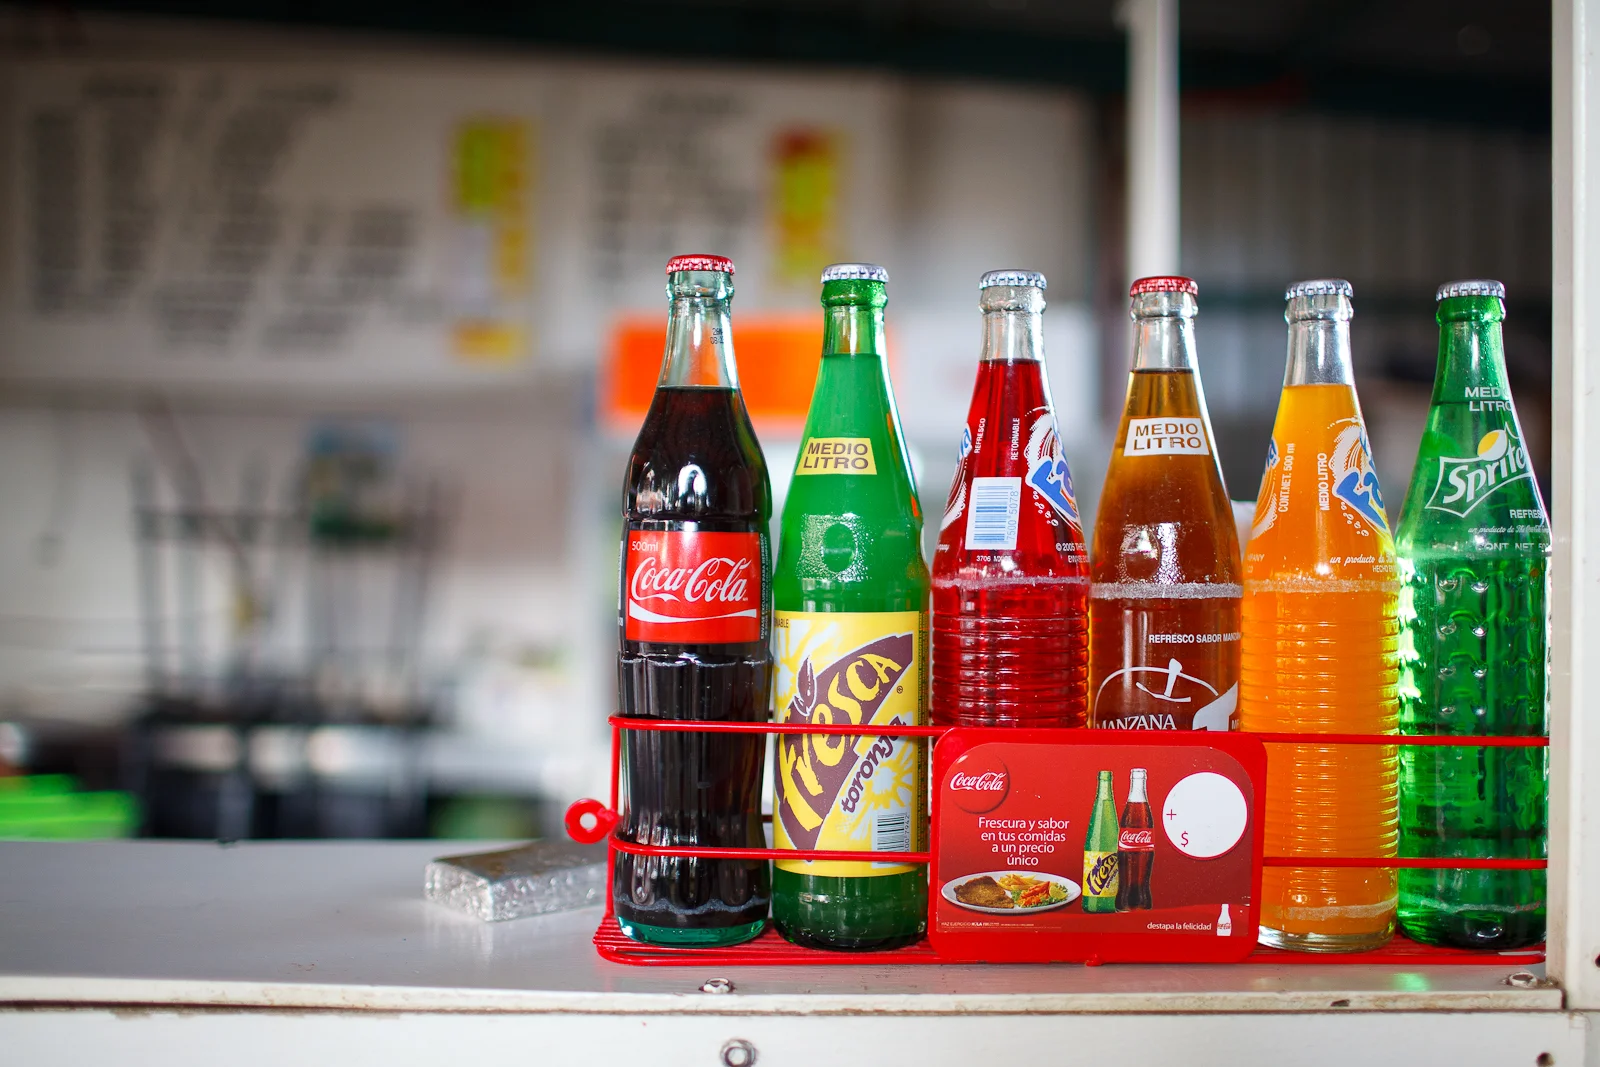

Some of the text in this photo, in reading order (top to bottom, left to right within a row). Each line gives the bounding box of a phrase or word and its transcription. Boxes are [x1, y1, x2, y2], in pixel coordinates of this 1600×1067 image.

[973, 417, 986, 454] REFRESCO
[1135, 423, 1199, 437] MEDIO
[1010, 417, 1020, 460] RETORNABLE
[1133, 437, 1202, 450] LITRO
[807, 442, 869, 456] MEDIO
[803, 456, 869, 470] LITRO
[1283, 455, 1294, 472] 500
[1442, 436, 1527, 504] Sprite
[1317, 453, 1330, 511] MEDIO LITRO
[632, 541, 658, 551] 500ml
[1343, 554, 1375, 566] producto
[631, 557, 751, 602] Coca-Cola
[1149, 634, 1194, 644] REFRESCO
[1196, 633, 1221, 642] SABOR
[950, 771, 1007, 790] Coca-Cola
[978, 817, 1070, 831] Frescura y sabor
[981, 830, 1066, 841] en tus comidas
[1121, 830, 1152, 843] Coca-Cola
[1181, 831, 1189, 848] $
[991, 842, 1055, 855] a un precio
[1006, 854, 1039, 866] único
[1147, 922, 1174, 931] destapa
[1183, 922, 1212, 931] felicidad
